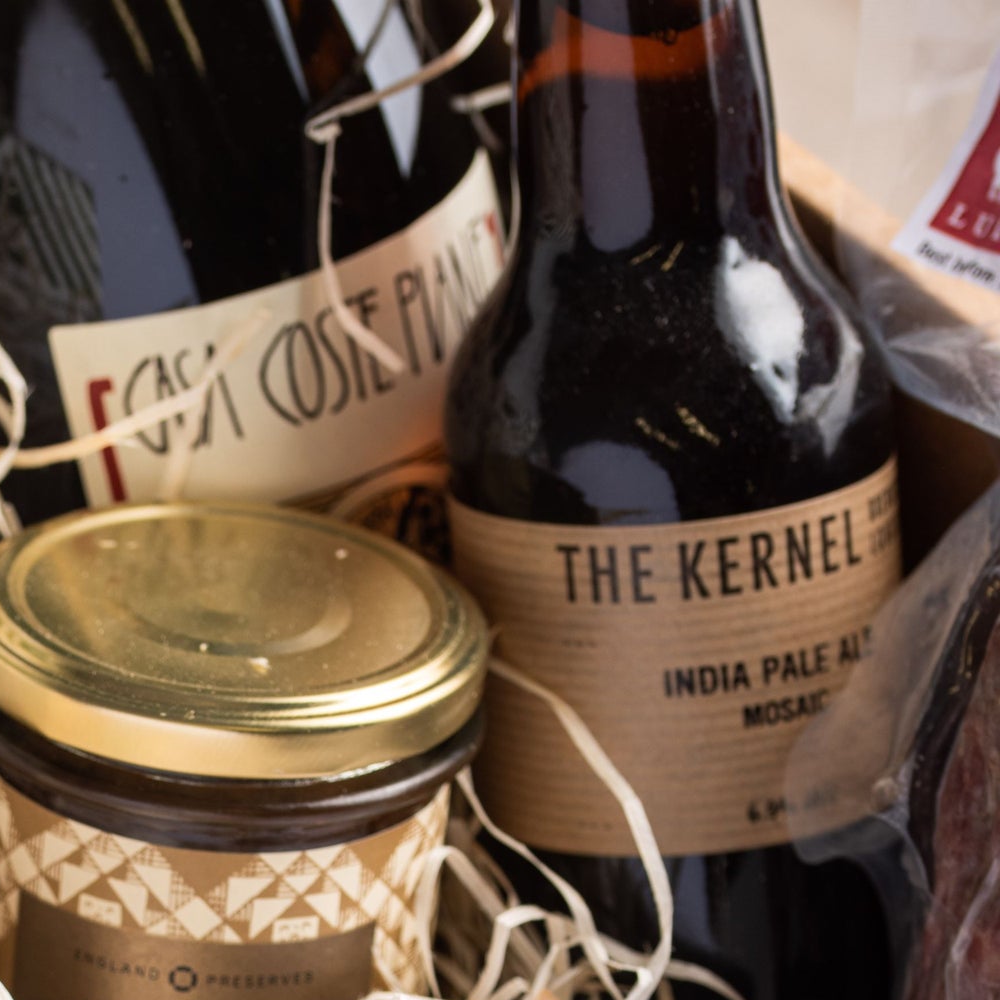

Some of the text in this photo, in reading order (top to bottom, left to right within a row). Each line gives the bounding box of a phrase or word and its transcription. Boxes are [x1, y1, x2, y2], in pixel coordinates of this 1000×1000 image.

[259, 287, 396, 427] COSTE
[556, 543, 657, 604] THE
[678, 509, 863, 601] KERNEL
[663, 661, 751, 698] INDIA
[762, 642, 830, 685] PALE
[73, 948, 162, 982] ENGLAND
